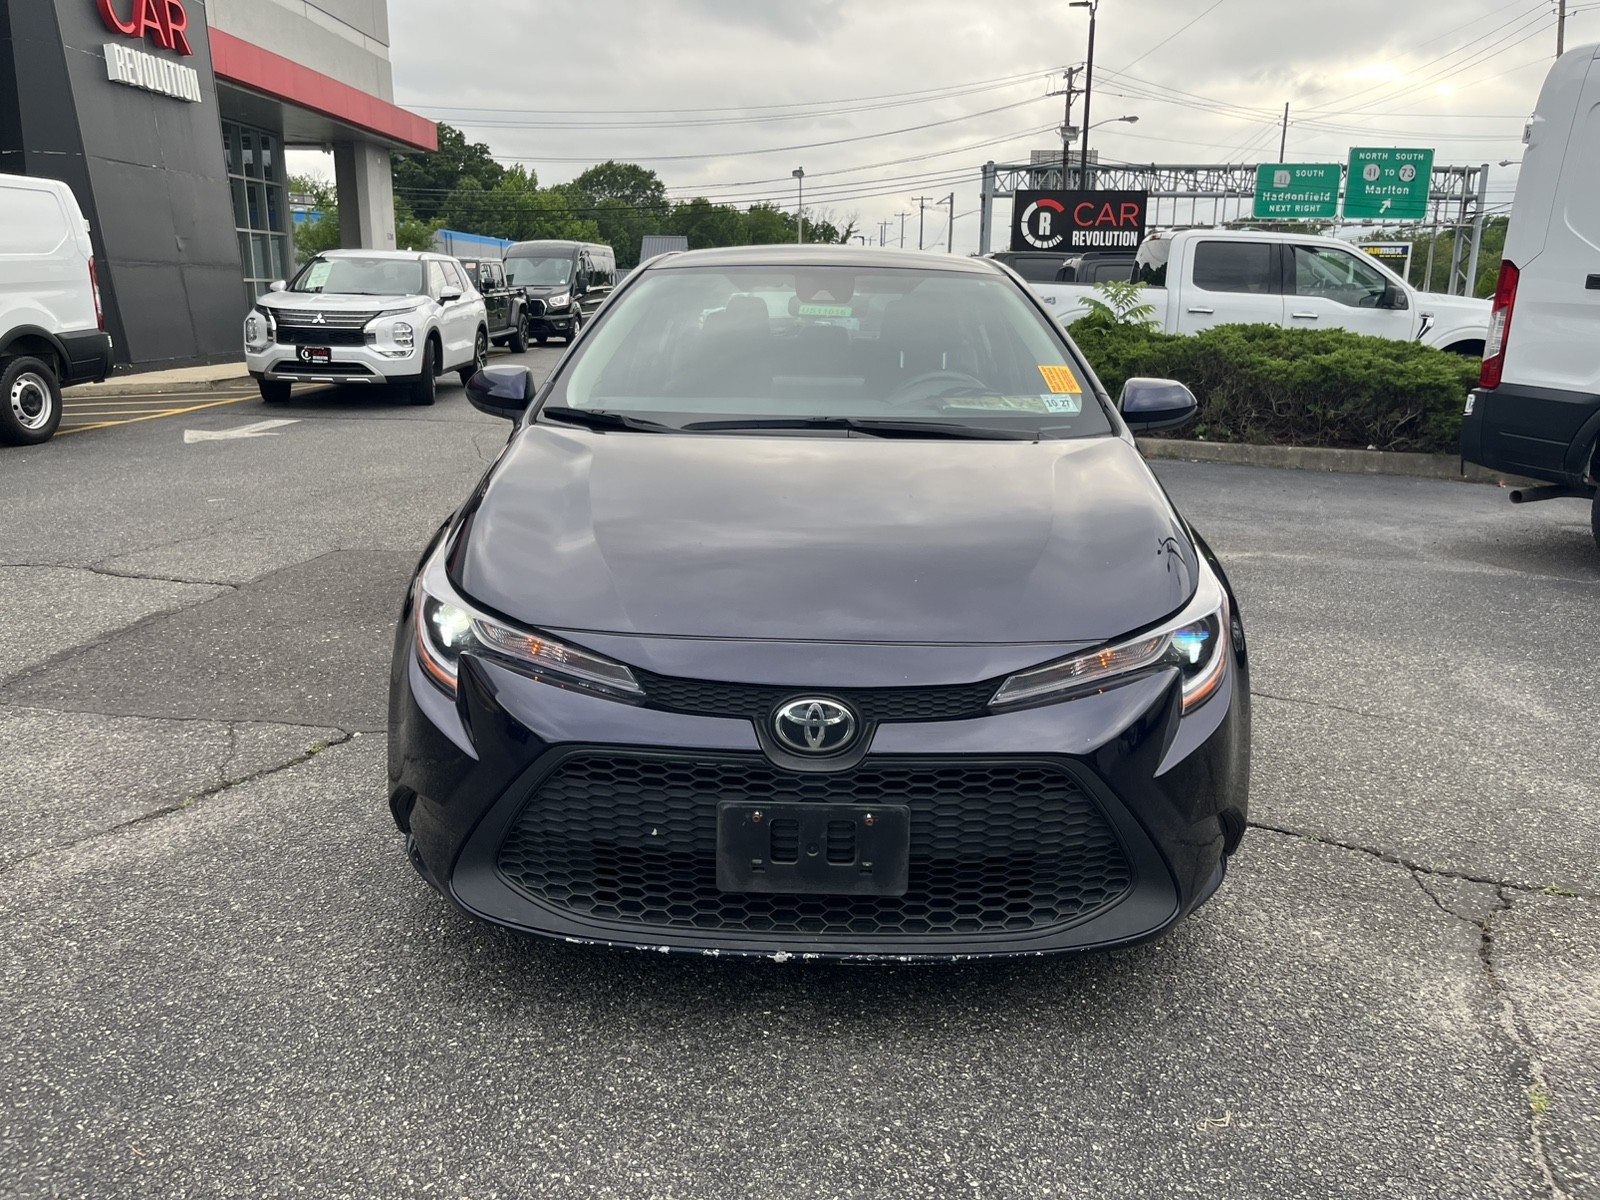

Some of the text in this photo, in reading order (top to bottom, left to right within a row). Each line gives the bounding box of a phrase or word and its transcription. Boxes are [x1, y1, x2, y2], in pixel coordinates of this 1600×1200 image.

[97, 0, 193, 56] CAR
[106, 43, 202, 103] REVOLUTION
[1359, 152, 1389, 160] NORTH
[1295, 169, 1325, 177] SOUTH
[1366, 168, 1376, 177] 41
[1401, 168, 1415, 178] 73
[1365, 185, 1409, 195] Marlton
[1262, 192, 1331, 201] Haddonfield
[1268, 204, 1321, 212] NEXT RIGHT
[1073, 202, 1140, 227] CAR
[1071, 230, 1139, 247] REVOLUTION
[1046, 399, 1070, 408] 10 27
